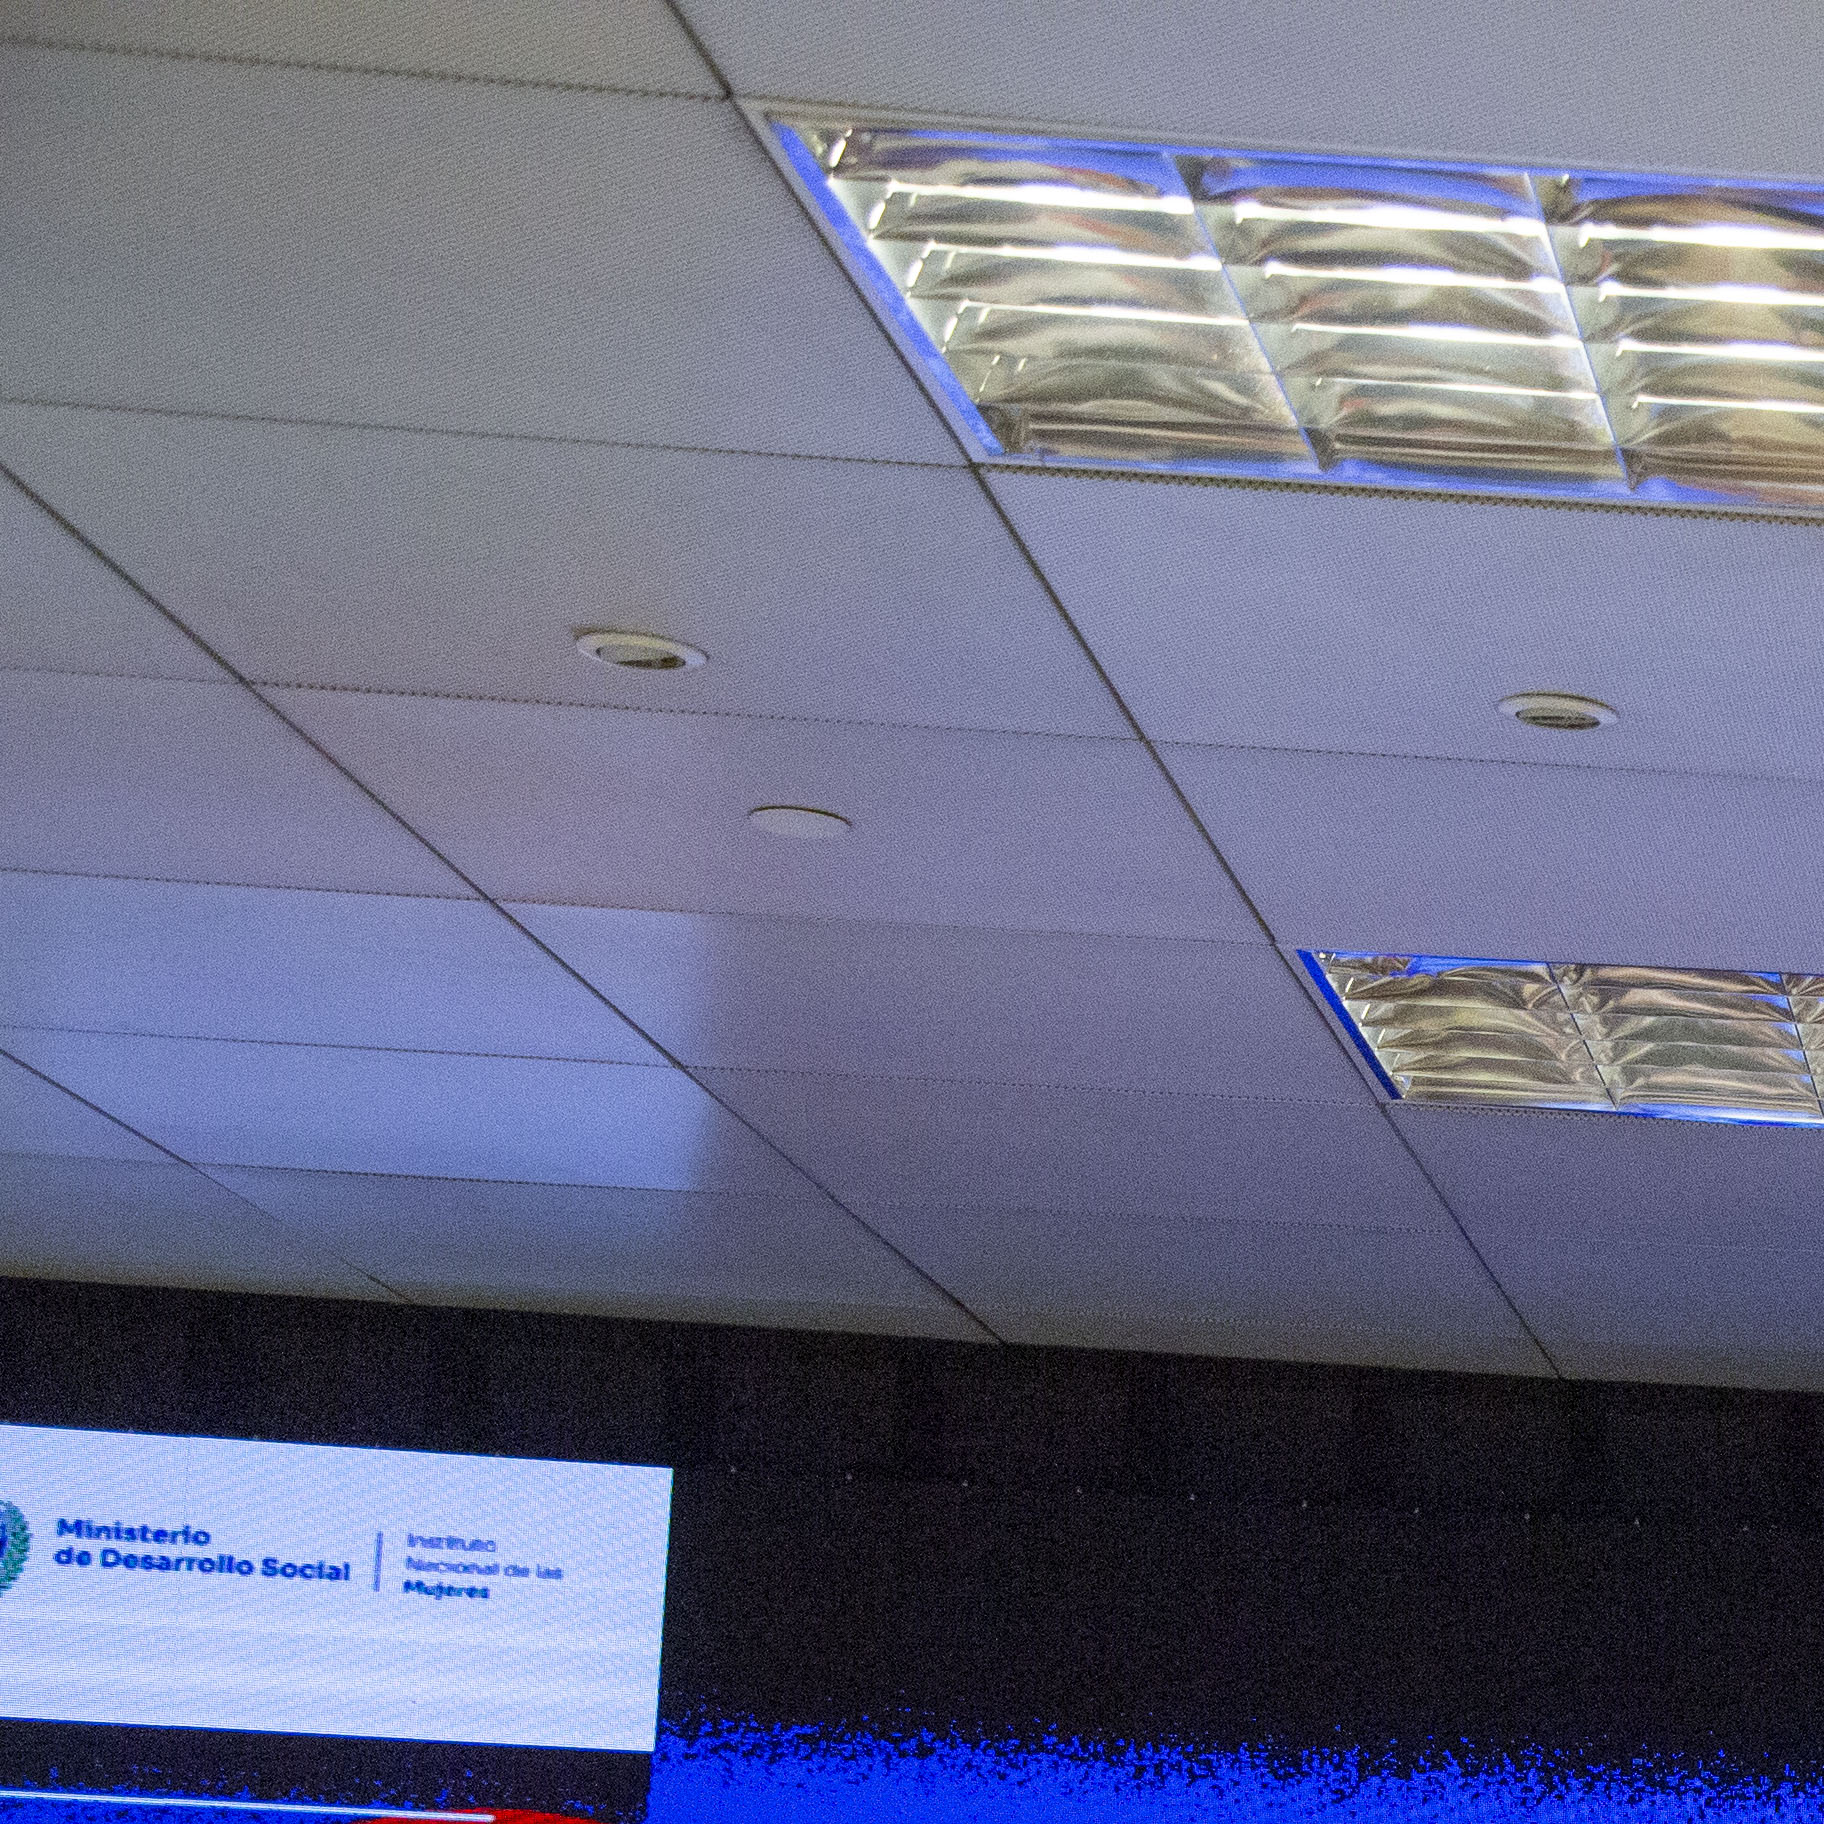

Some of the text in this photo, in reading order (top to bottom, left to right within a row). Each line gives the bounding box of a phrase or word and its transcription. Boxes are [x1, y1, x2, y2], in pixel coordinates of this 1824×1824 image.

[56, 1518, 211, 1548] Ministerio
[406, 1532, 497, 1554] Instituto
[54, 1546, 351, 1583] de Desarrollo Social
[404, 1556, 564, 1581] Nacional de las
[402, 1579, 491, 1602] Mujeres
